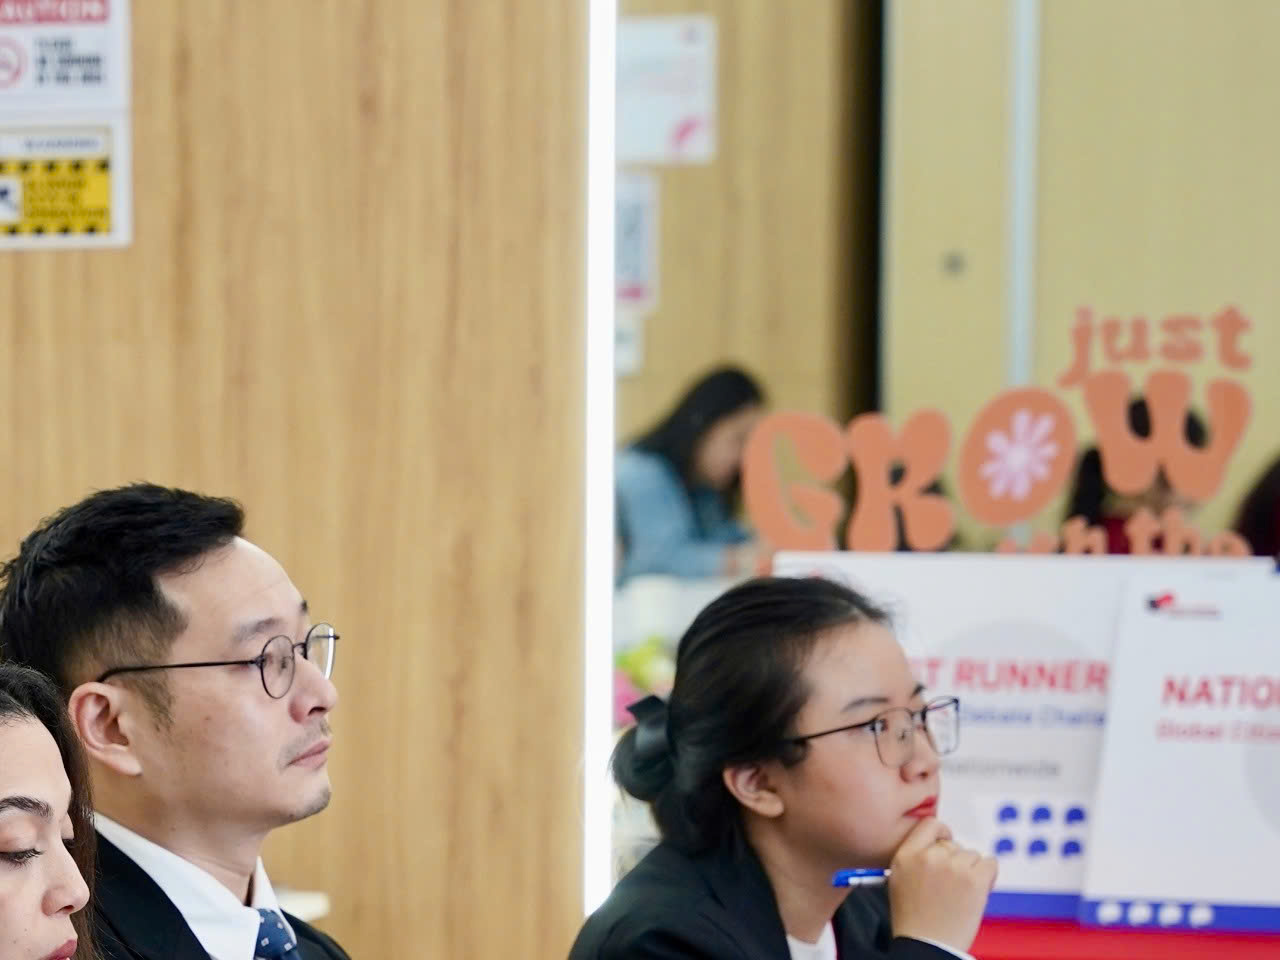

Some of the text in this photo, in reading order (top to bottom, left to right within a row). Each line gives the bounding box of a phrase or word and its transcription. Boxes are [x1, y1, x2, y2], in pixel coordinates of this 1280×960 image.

[1057, 306, 1253, 388] just
[741, 370, 1253, 553] GROW
[954, 656, 1110, 693] RUNNER
